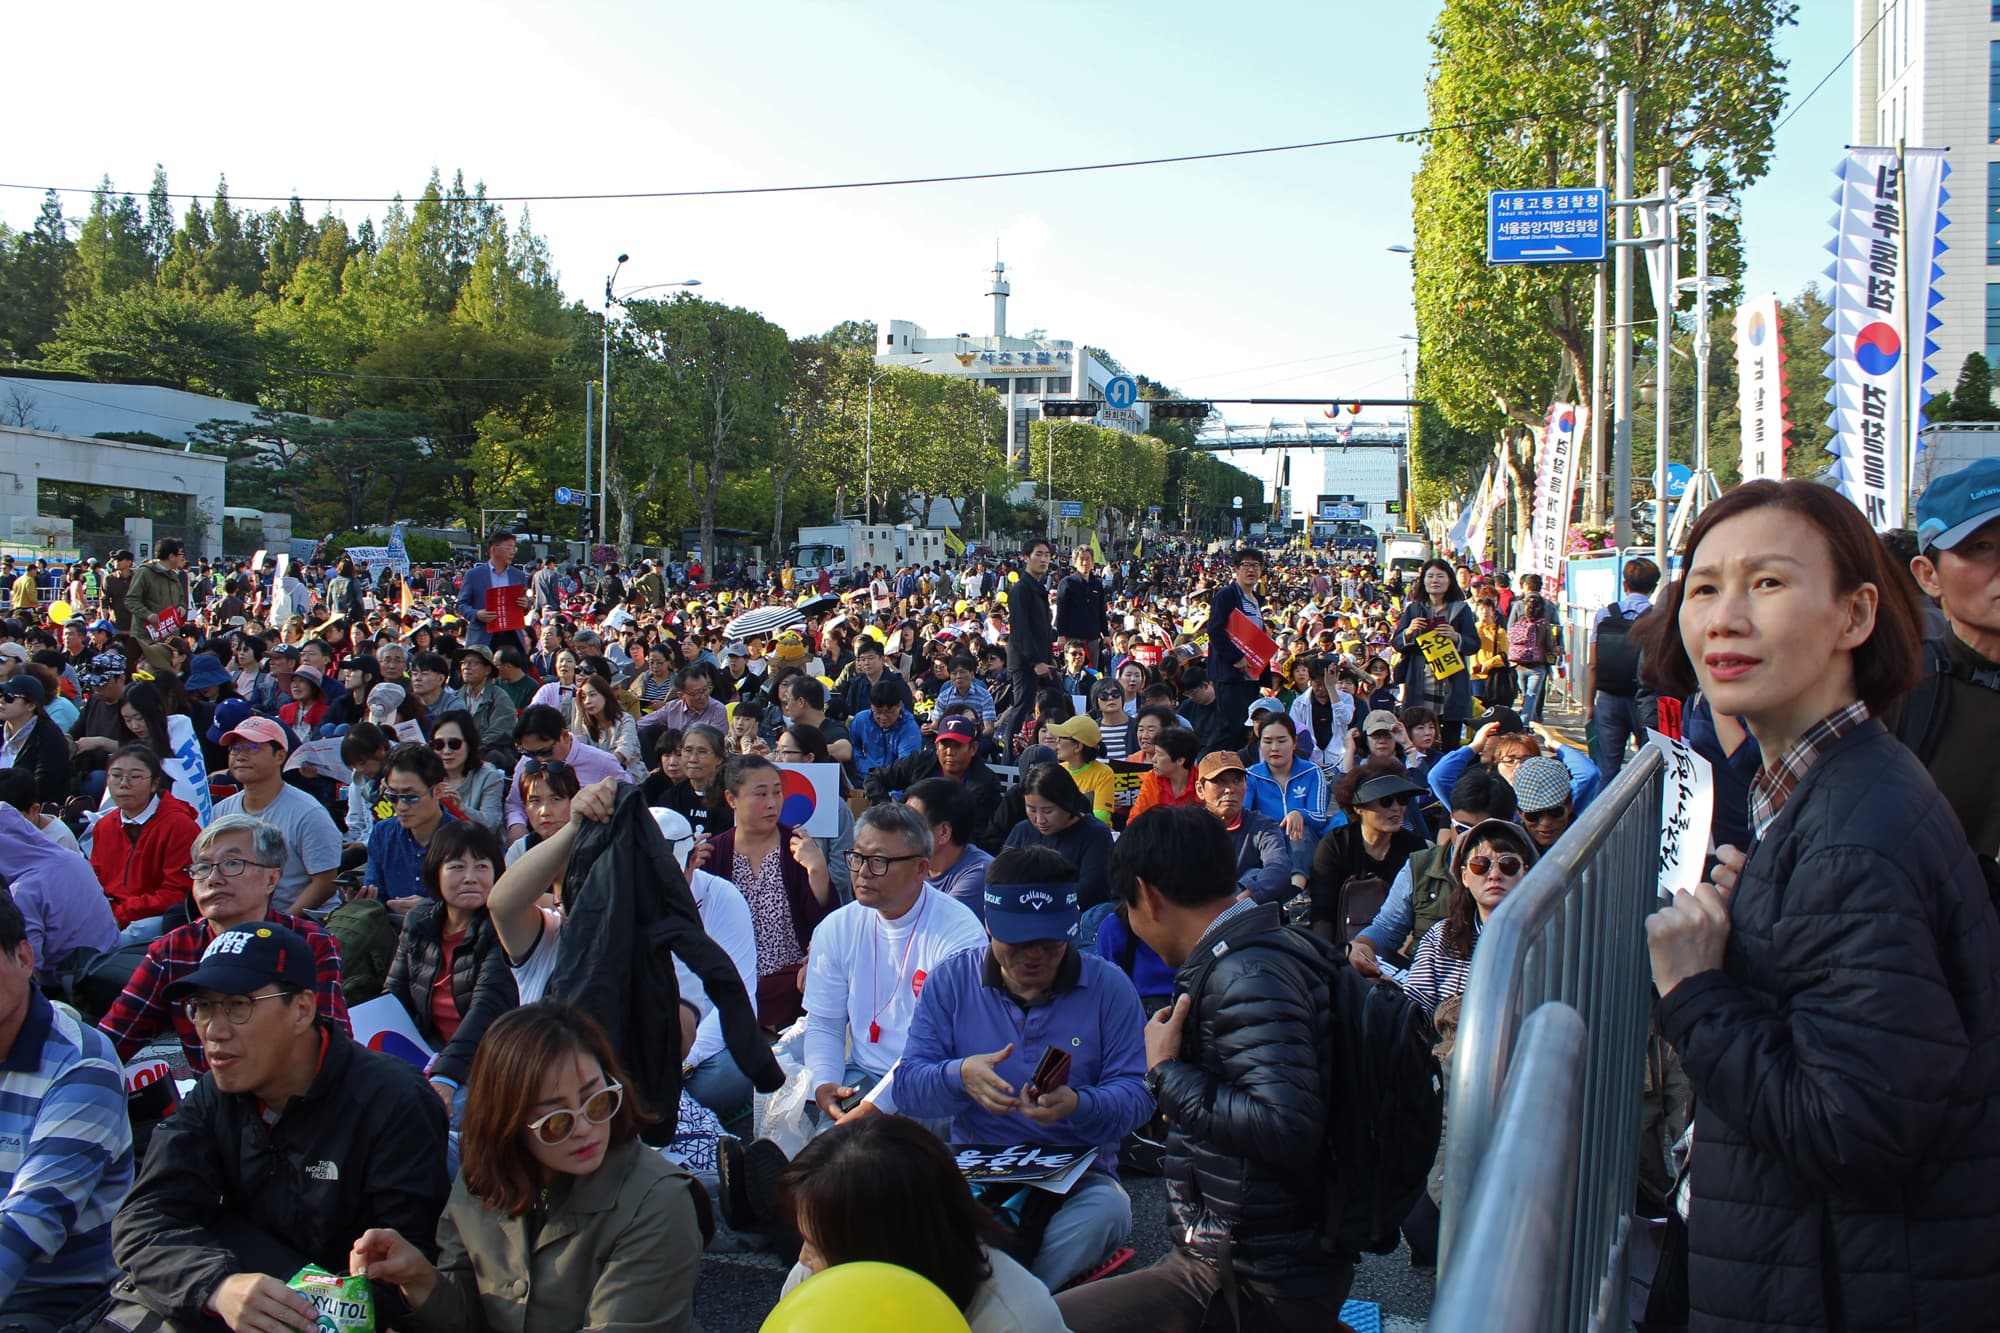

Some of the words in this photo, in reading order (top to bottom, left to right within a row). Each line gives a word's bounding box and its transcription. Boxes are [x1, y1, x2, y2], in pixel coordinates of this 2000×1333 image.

[1498, 195, 1598, 210] 서울고등검찰청
[1498, 219, 1598, 235] 서울중앙지방검찰청
[980, 351, 1072, 366] 서초경찰서
[1103, 410, 1136, 420] 좌회전시
[1420, 633, 1451, 655] 수호
[1430, 651, 1460, 673] 개혁
[690, 808, 694, 817] I
[695, 809, 708, 818] AM
[1019, 889, 1054, 904] Callaway
[311, 1172, 329, 1180] FACE
[311, 1294, 367, 1320] XYLITOL
